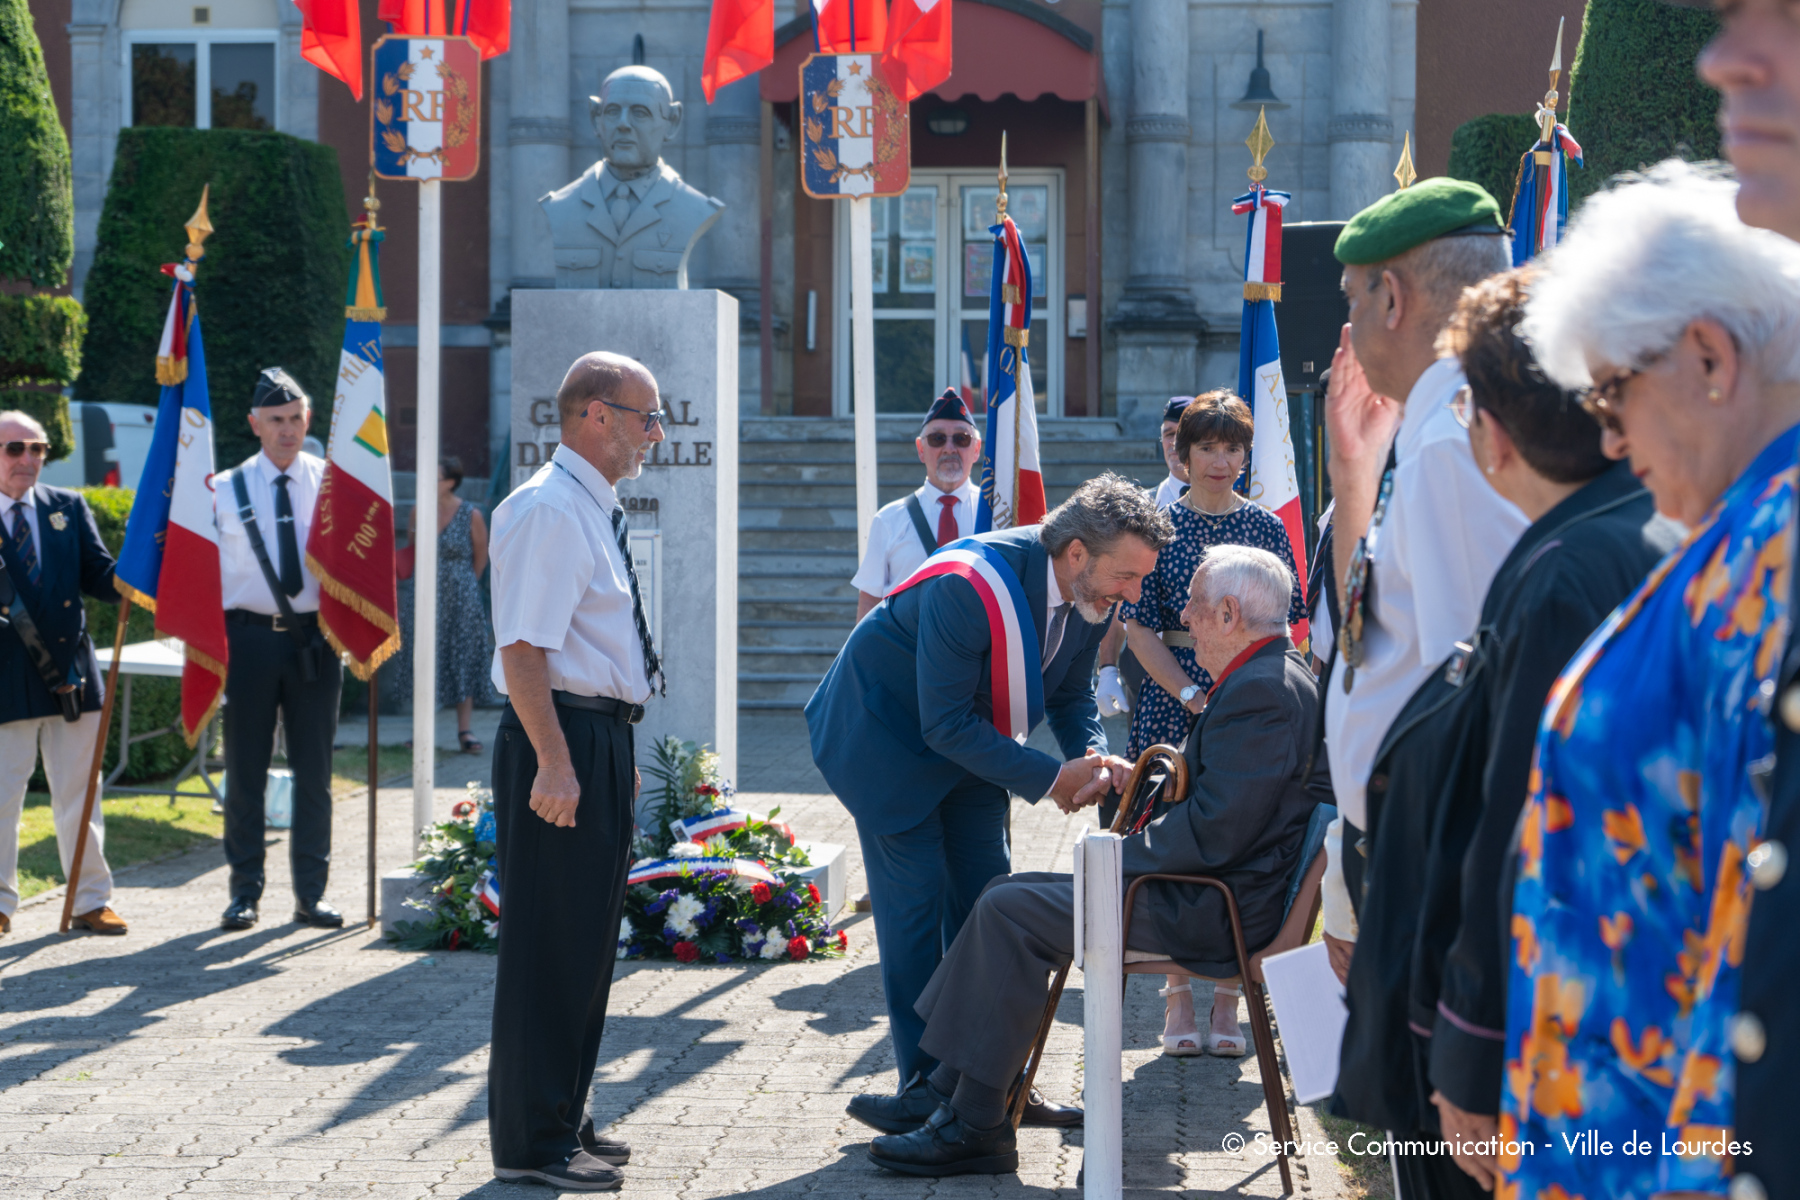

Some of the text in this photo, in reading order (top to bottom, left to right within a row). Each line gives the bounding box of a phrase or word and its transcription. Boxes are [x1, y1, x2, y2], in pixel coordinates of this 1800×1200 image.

[397, 89, 451, 122] RF
[828, 105, 881, 138] RF
[320, 498, 333, 536] LES
[340, 336, 382, 387] MILIT
